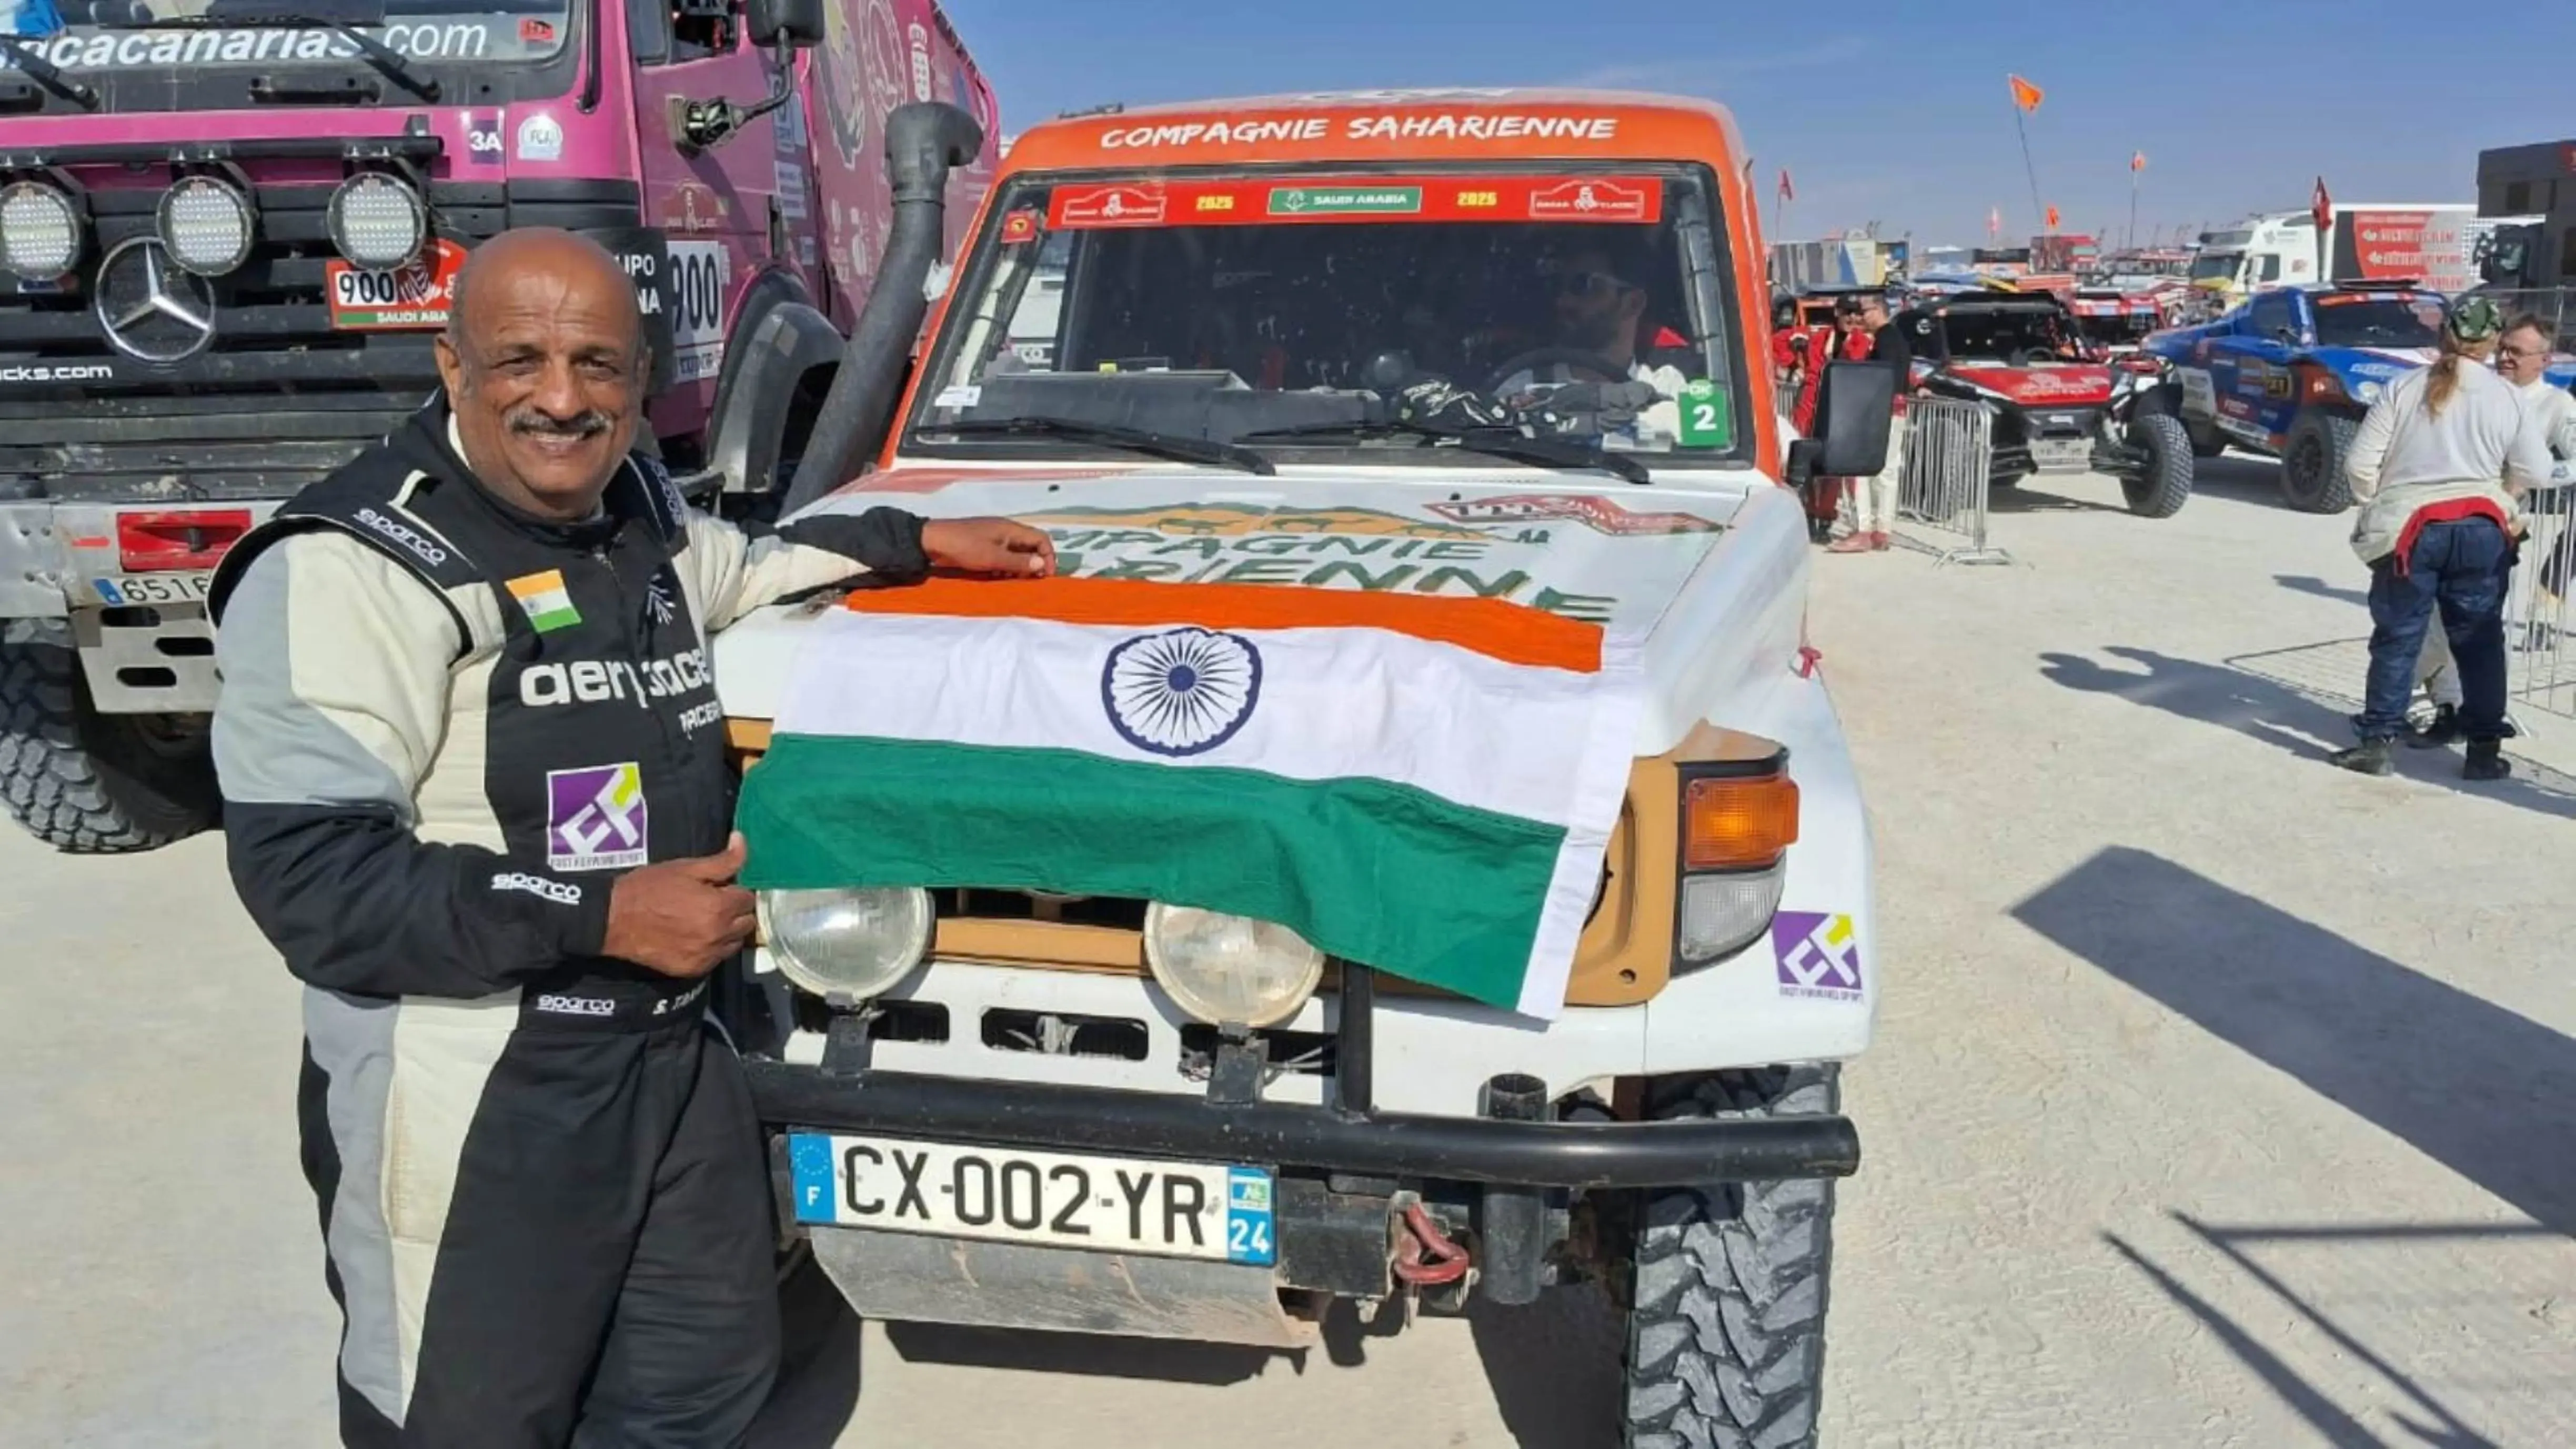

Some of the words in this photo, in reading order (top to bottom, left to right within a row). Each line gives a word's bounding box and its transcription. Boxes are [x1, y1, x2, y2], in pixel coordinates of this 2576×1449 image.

[470, 130, 504, 151] 3A
[1101, 118, 1330, 148] COMPAGNIE
[1347, 114, 1620, 140] SAHARIENNE
[1356, 194, 1407, 205] ARABIA
[1457, 192, 1498, 206] 2025
[339, 272, 395, 304] 900
[670, 253, 720, 333] 900
[377, 311, 418, 324] SAUDI
[421, 311, 448, 323] ARA
[0, 365, 113, 381] cks.com
[1693, 404, 1717, 431] 2
[353, 508, 447, 567] sparco
[491, 873, 581, 904] sparco
[536, 994, 615, 1015] sparco
[807, 1185, 821, 1206] F
[843, 1145, 1207, 1246] CX-002-YR
[1231, 1219, 1270, 1254] 24
